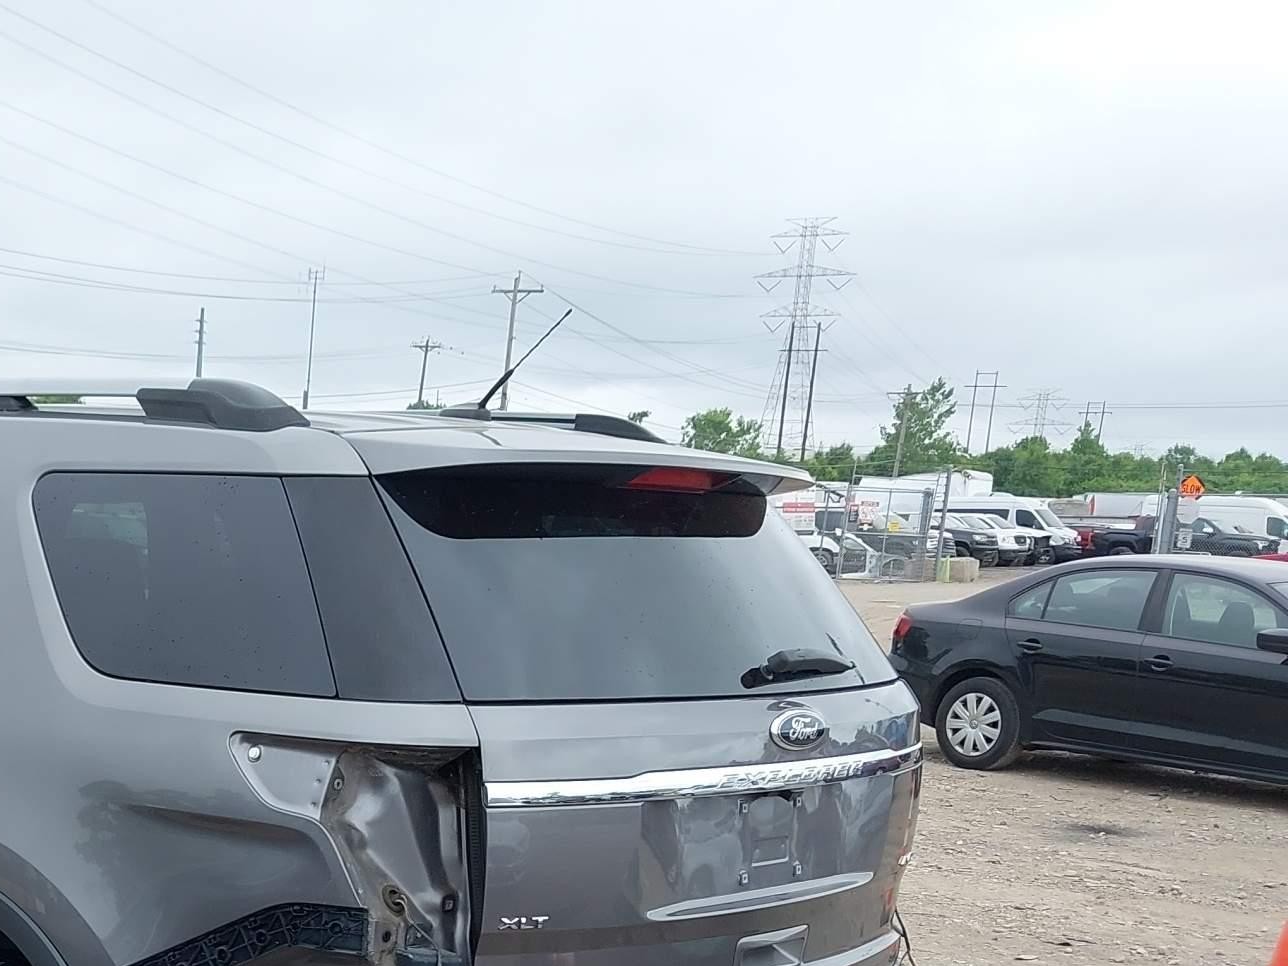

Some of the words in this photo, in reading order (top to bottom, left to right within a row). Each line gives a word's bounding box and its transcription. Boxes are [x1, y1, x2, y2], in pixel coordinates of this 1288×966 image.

[1182, 484, 1202, 494] SLOW
[789, 716, 819, 740] Ford
[717, 760, 863, 789] EXPLORER
[497, 916, 549, 930] XLT
